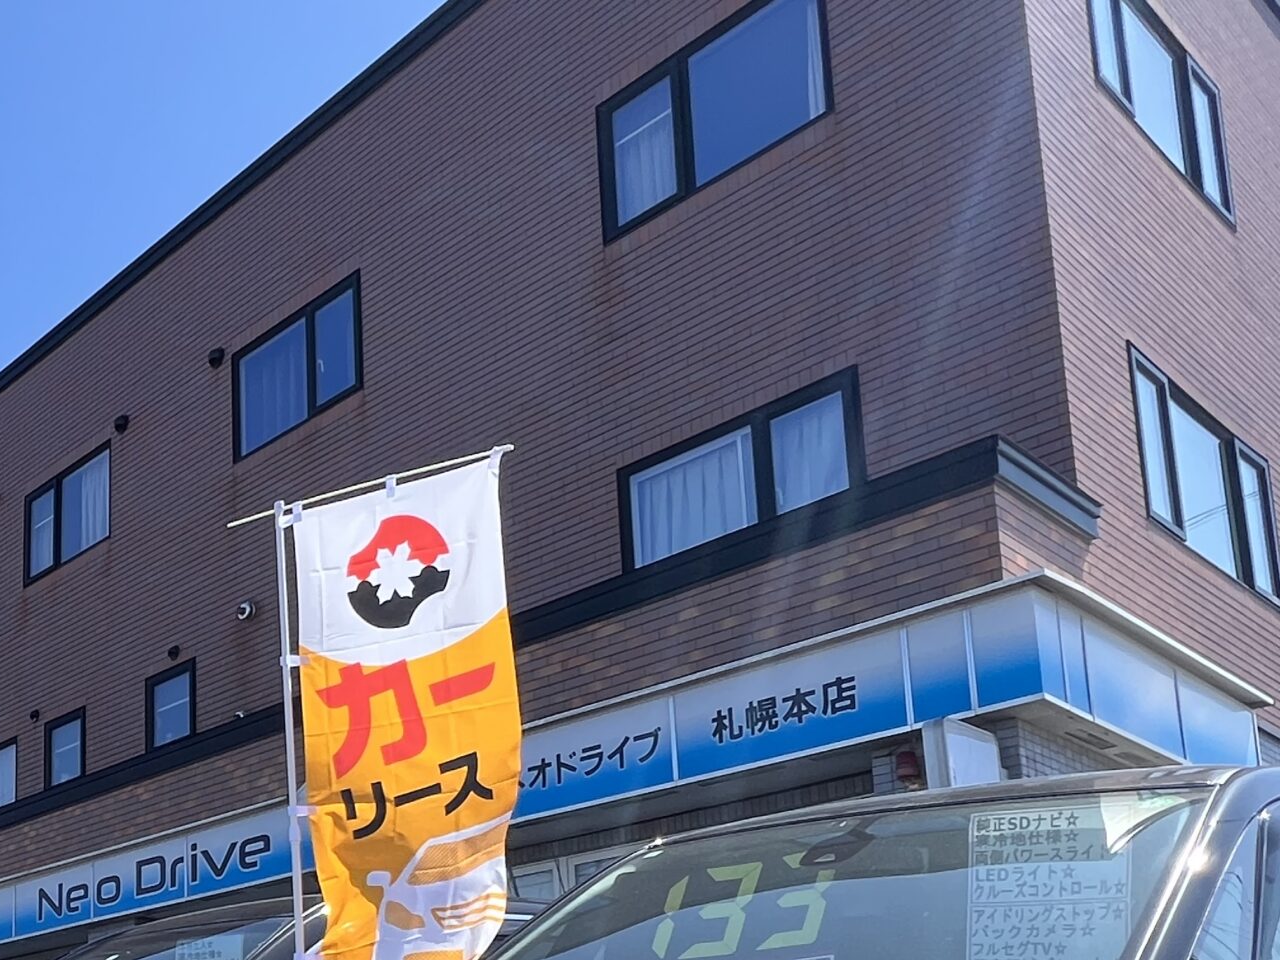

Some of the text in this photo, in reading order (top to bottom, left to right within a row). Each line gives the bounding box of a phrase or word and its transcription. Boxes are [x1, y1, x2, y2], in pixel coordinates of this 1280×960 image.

[315, 658, 495, 780] カー
[711, 675, 857, 744] 札幌本店
[340, 751, 494, 840] リース
[518, 727, 662, 790] オドライブ
